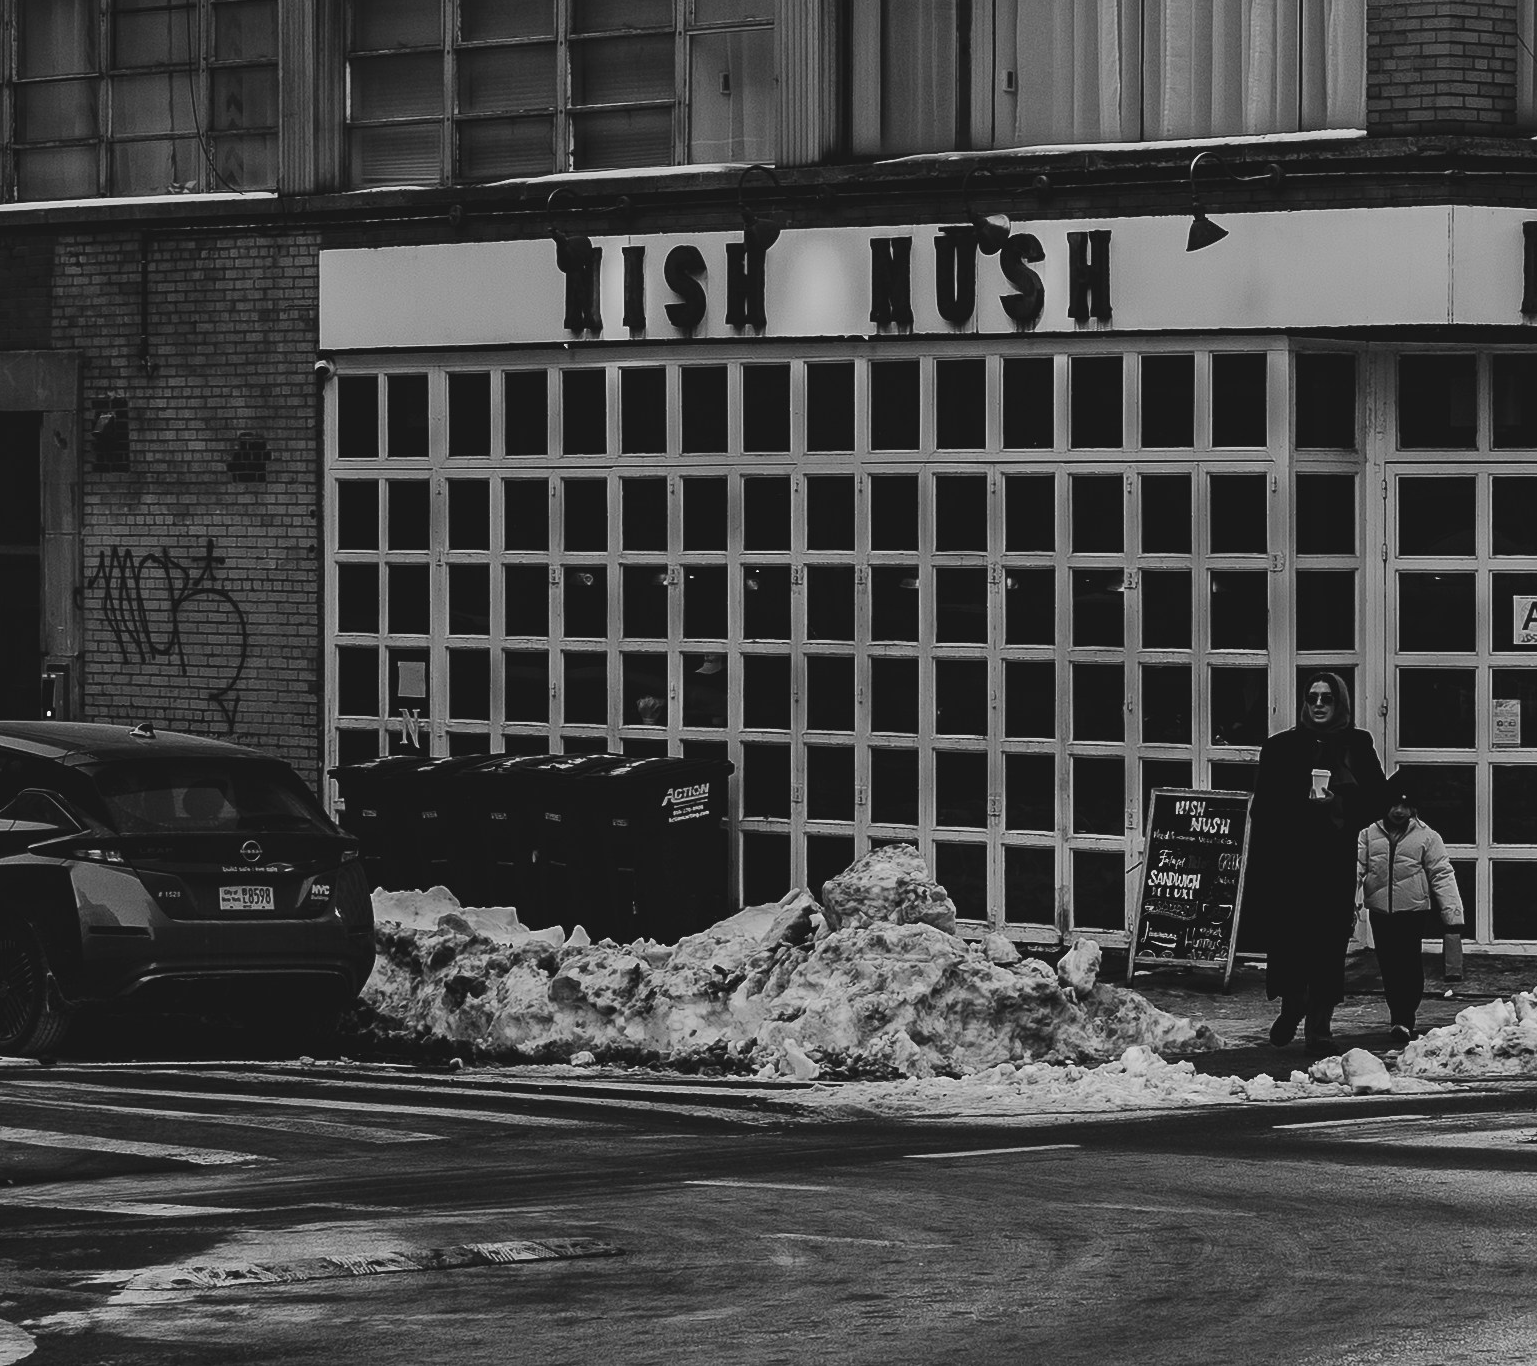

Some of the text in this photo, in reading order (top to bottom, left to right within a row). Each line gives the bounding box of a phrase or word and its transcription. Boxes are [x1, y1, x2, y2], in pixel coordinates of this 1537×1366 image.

[399, 708, 421, 749] N
[662, 782, 710, 807] ACTION
[1175, 801, 1206, 816] NISH
[1189, 817, 1231, 835] NUSH
[311, 884, 330, 895] NYC
[1147, 870, 1201, 890] SANDWICH
